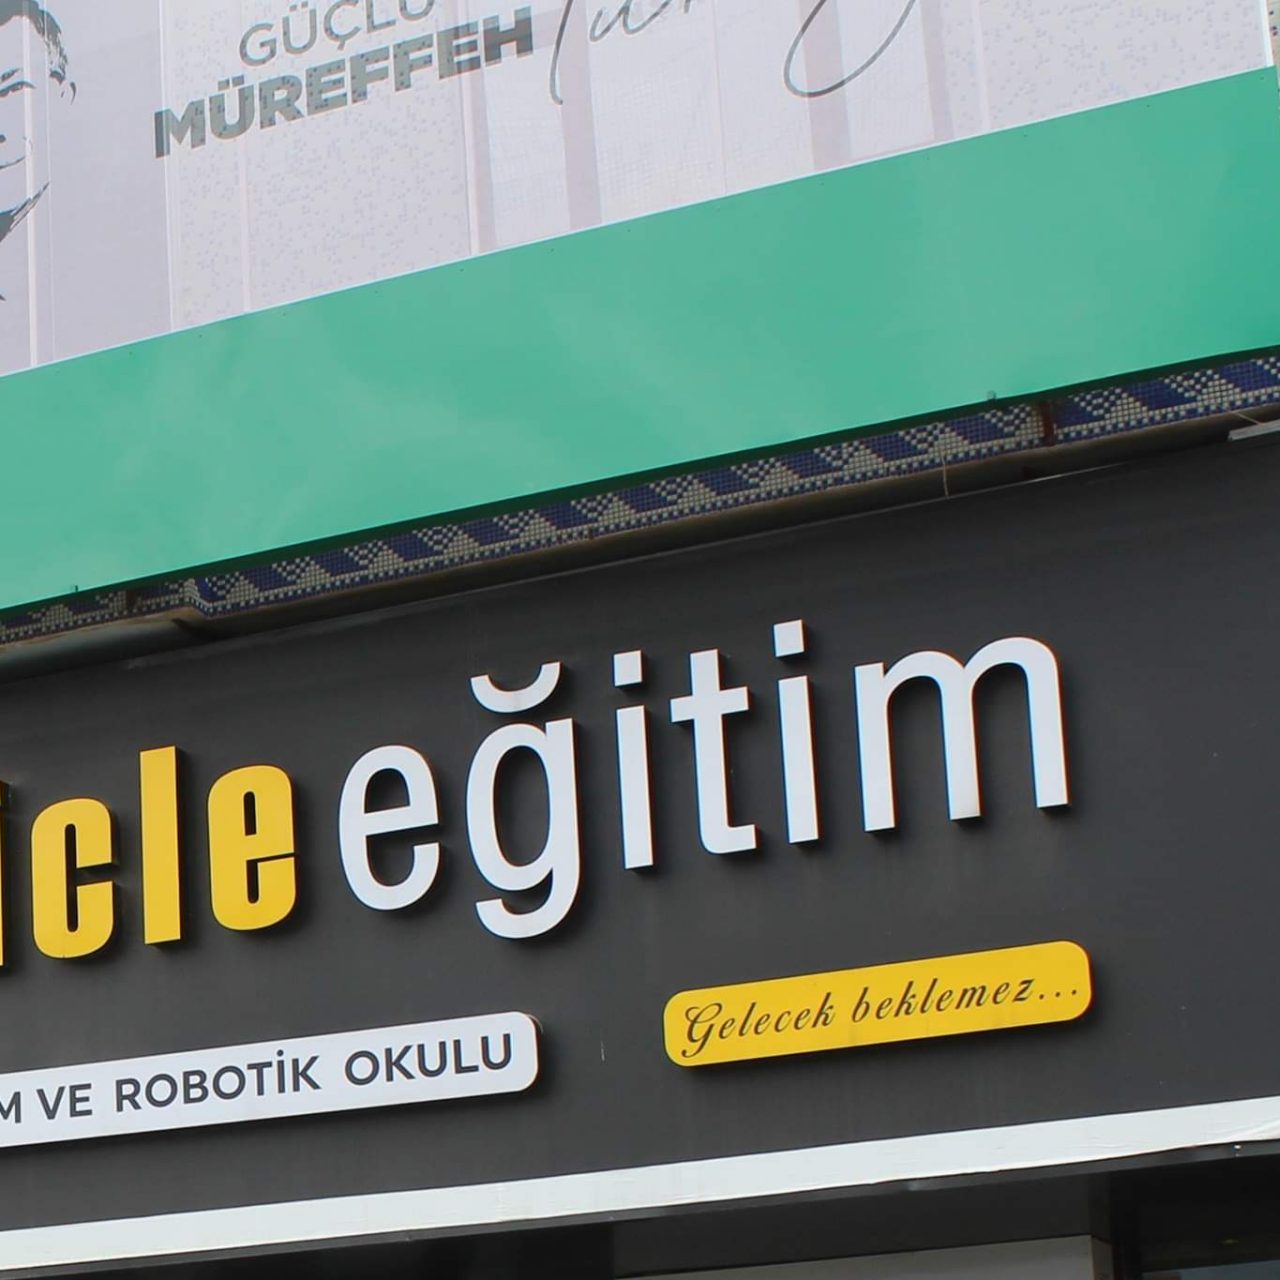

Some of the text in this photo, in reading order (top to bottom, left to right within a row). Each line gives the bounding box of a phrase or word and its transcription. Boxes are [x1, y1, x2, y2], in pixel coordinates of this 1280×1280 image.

[154, 6, 534, 159] MÜREFFEH
[338, 619, 1068, 939] eğitim
[36, 1083, 94, 1121] VE
[115, 1049, 320, 1113] ROBOTİK
[345, 1032, 513, 1086] OKULU
[681, 977, 1078, 1058] Gelecek beklemez...
